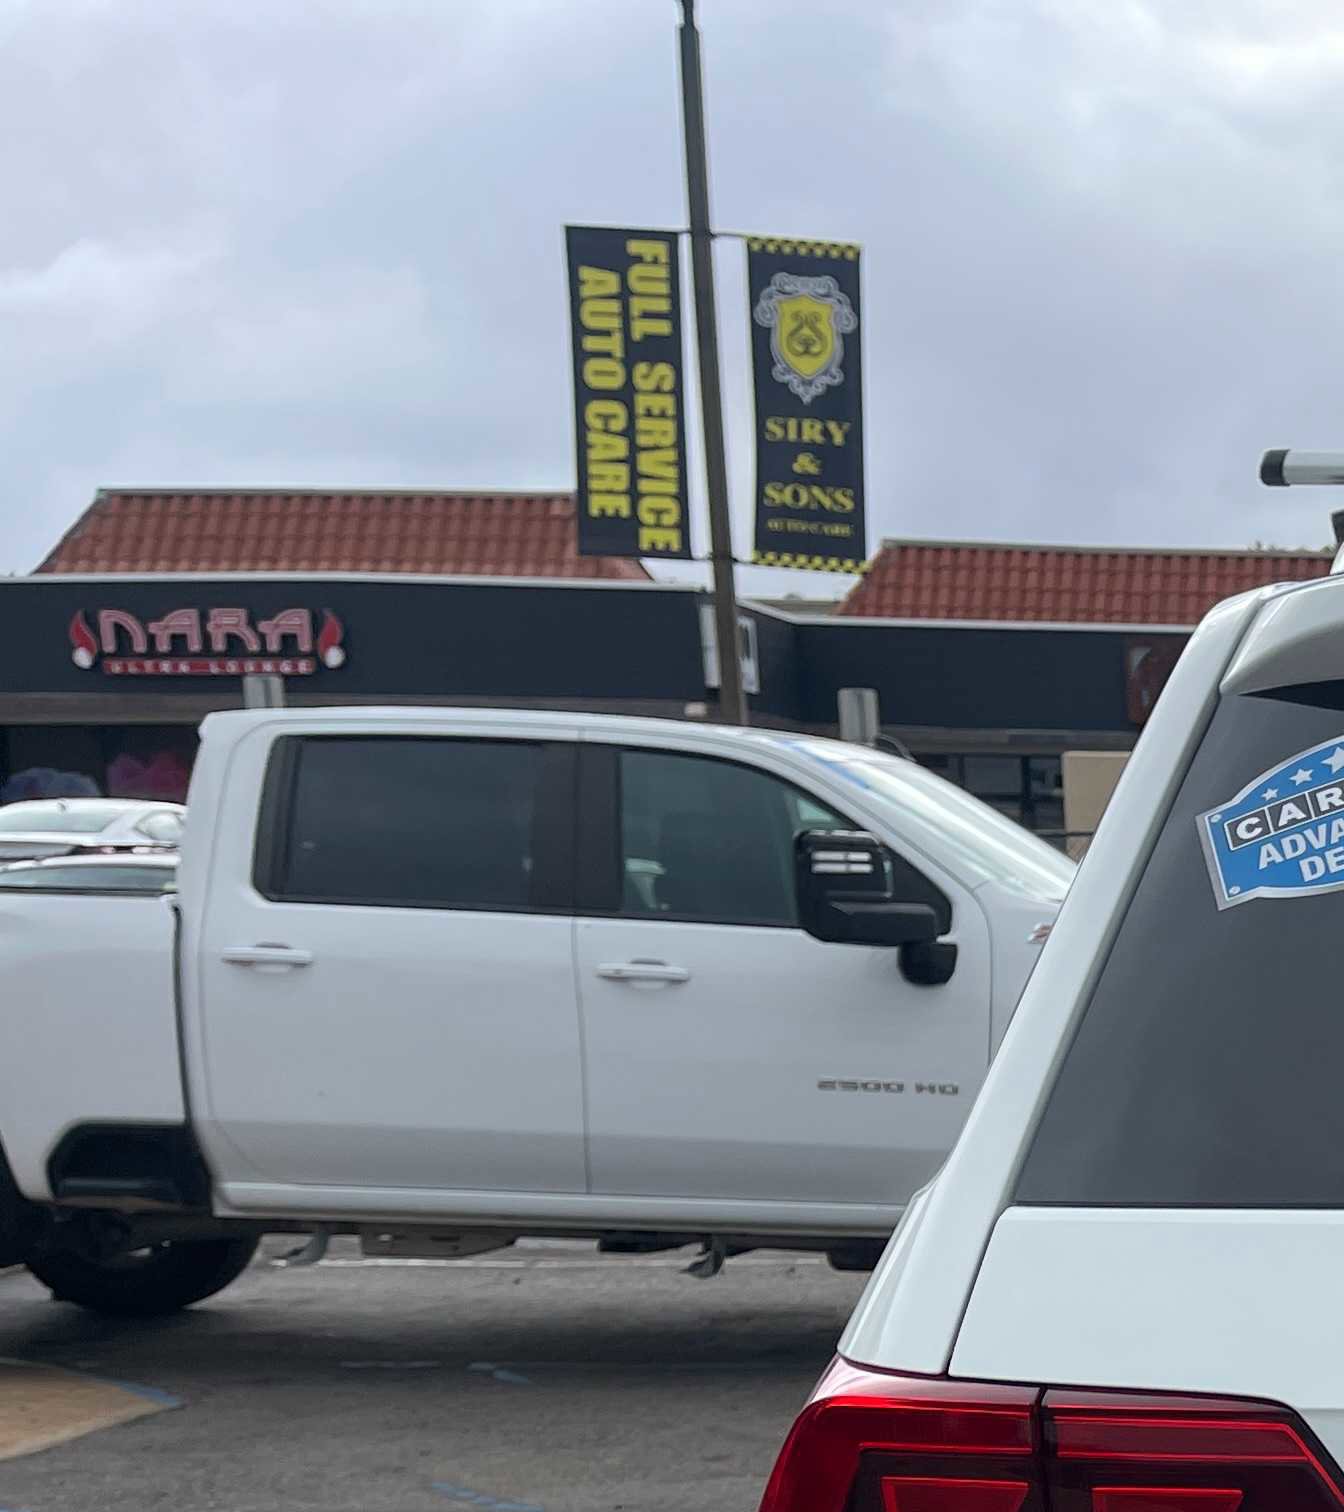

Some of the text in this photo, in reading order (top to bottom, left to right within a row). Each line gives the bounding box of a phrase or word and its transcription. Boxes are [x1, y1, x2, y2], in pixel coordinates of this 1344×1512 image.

[578, 265, 631, 519] AUTO CARE
[627, 239, 682, 552] FULL SERVICE
[764, 416, 851, 446] SIRY
[792, 452, 821, 475] &
[763, 482, 855, 513] SONS
[98, 608, 313, 653] NARA
[817, 1080, 959, 1096] 2500 HD
